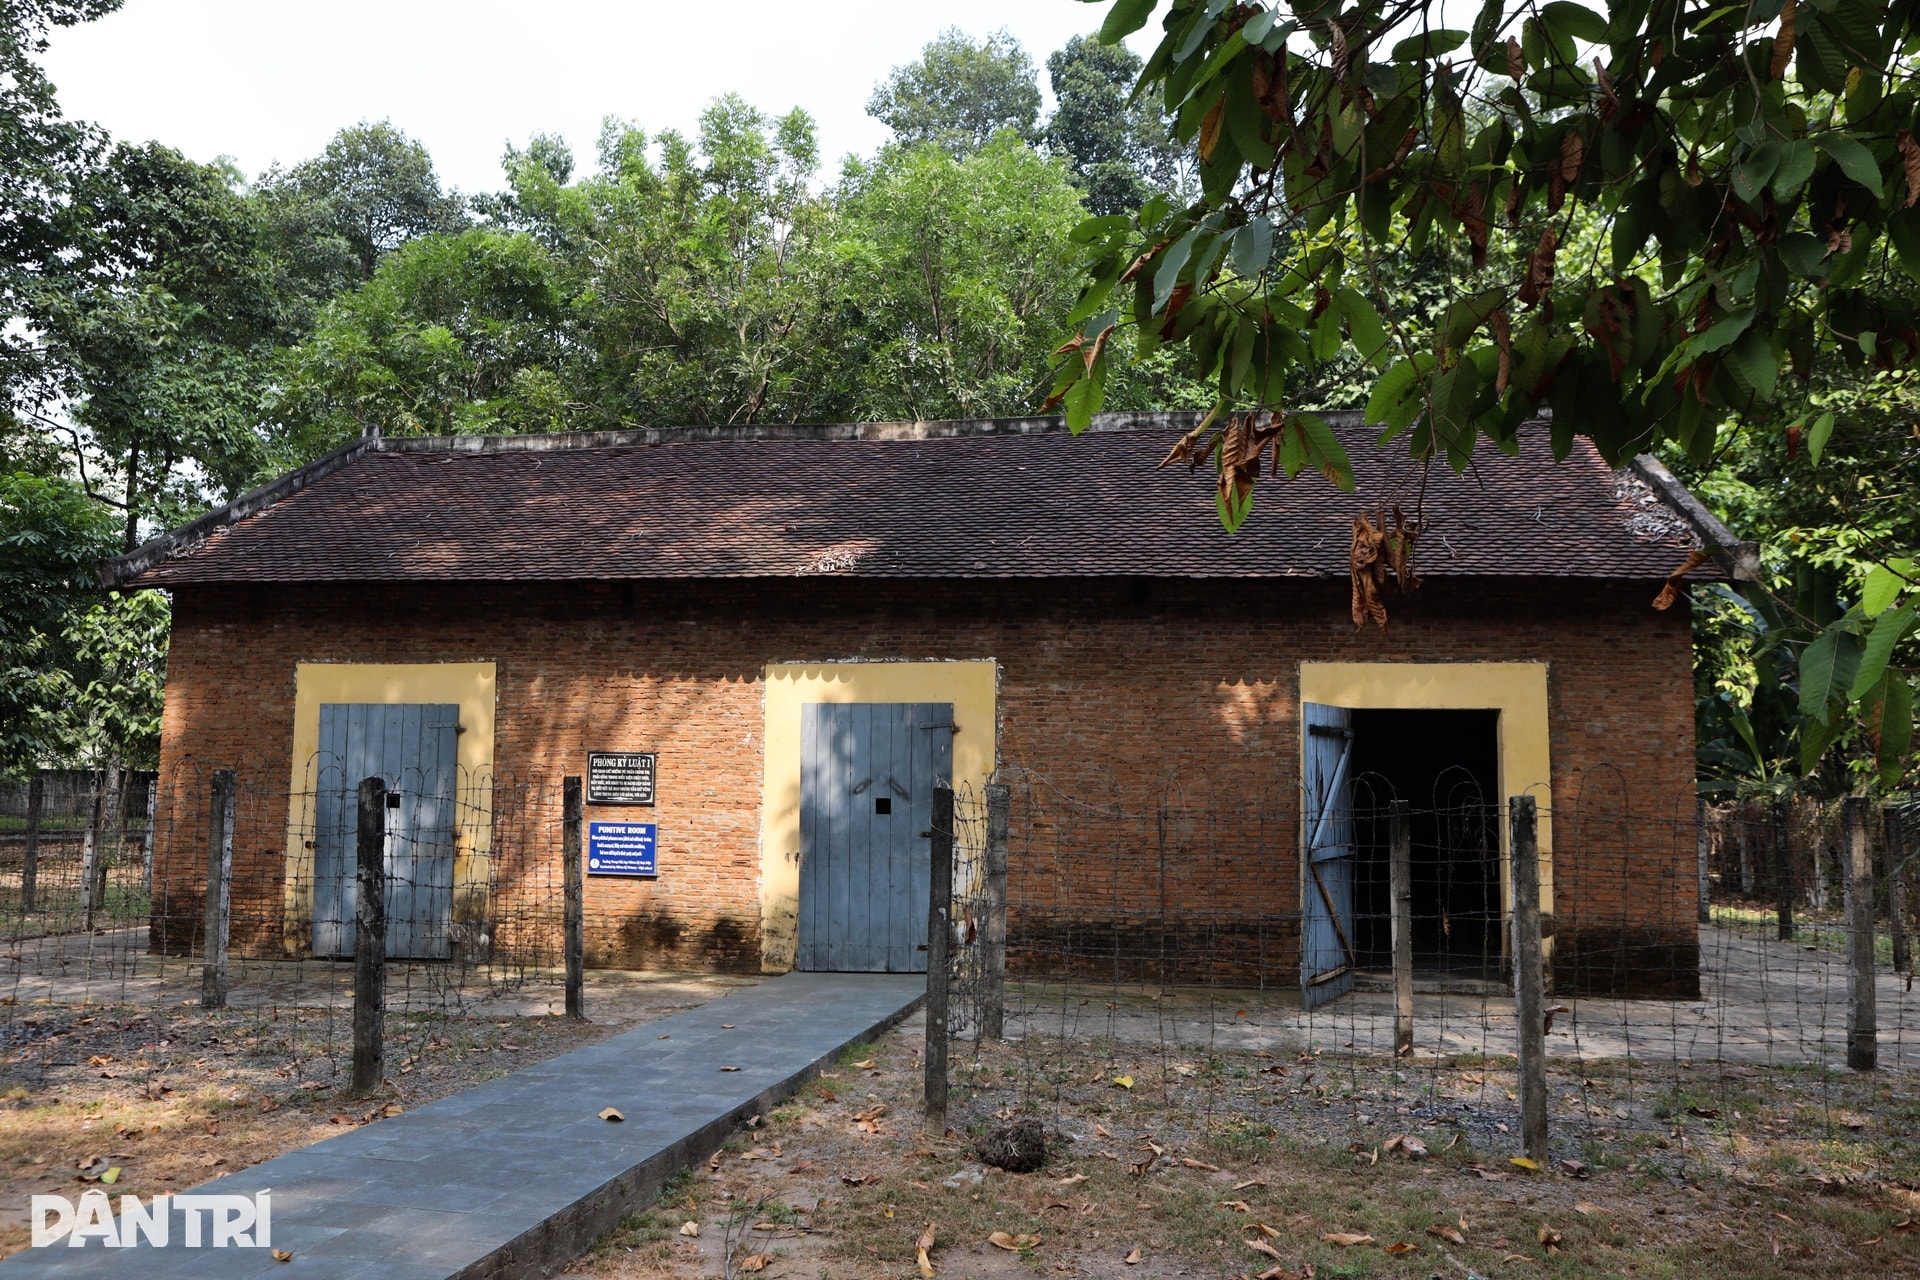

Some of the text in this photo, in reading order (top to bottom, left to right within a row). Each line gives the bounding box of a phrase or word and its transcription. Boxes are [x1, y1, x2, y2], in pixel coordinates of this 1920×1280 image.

[593, 756, 617, 767] PHÒNG
[628, 756, 646, 769] LUẬT
[598, 826, 626, 834] PUNITIVE
